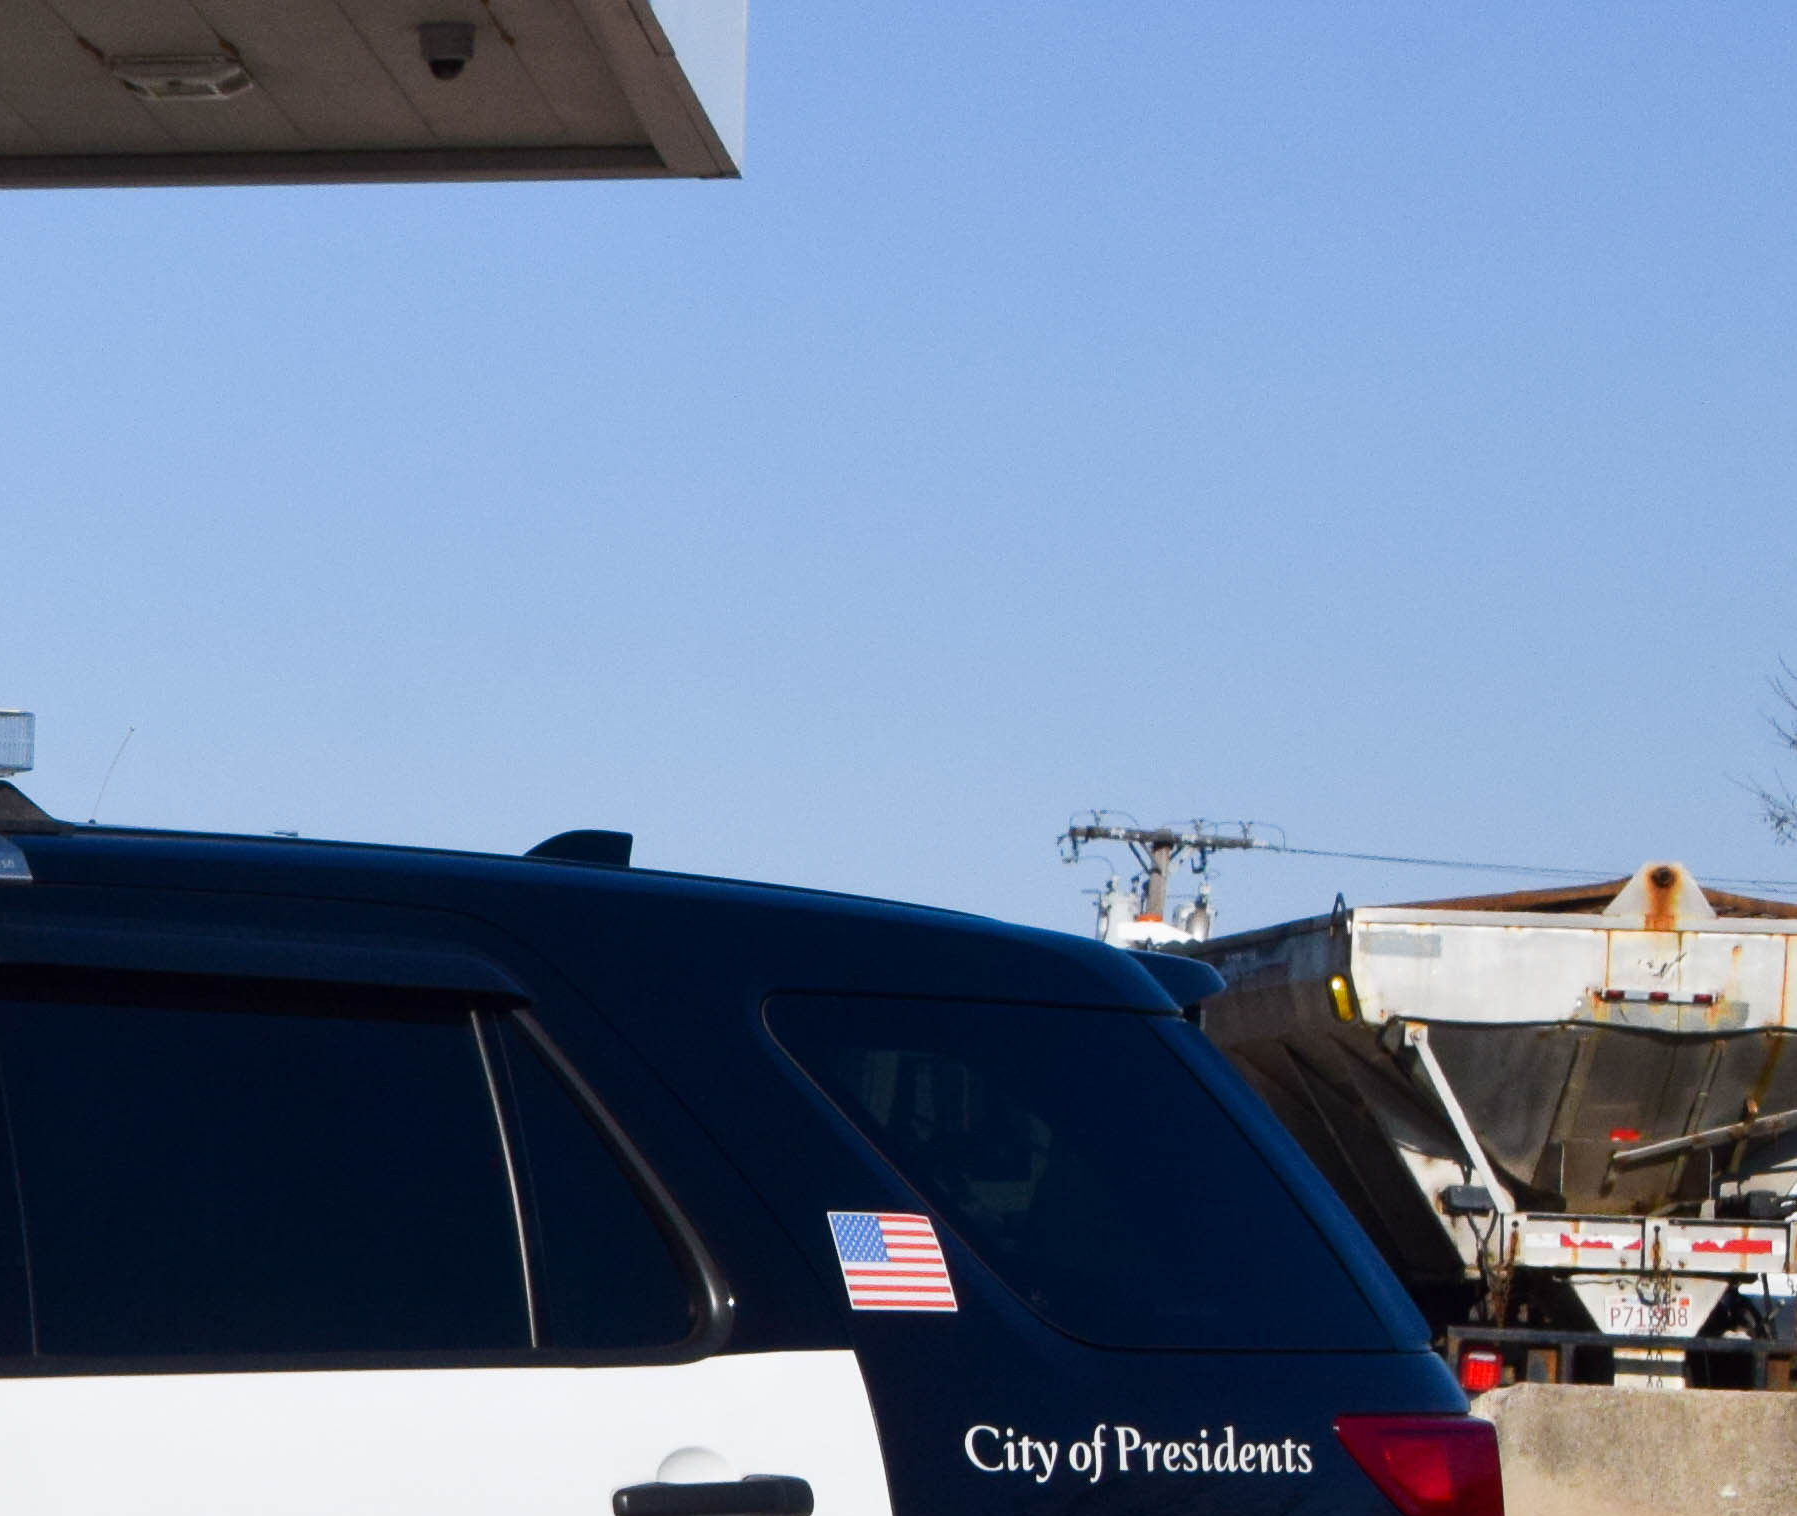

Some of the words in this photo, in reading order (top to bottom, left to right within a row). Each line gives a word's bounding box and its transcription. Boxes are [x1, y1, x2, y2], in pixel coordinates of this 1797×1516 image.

[964, 1425, 1058, 1483] City
[1069, 1424, 1106, 1483] of
[1114, 1425, 1313, 1473] Presidents
